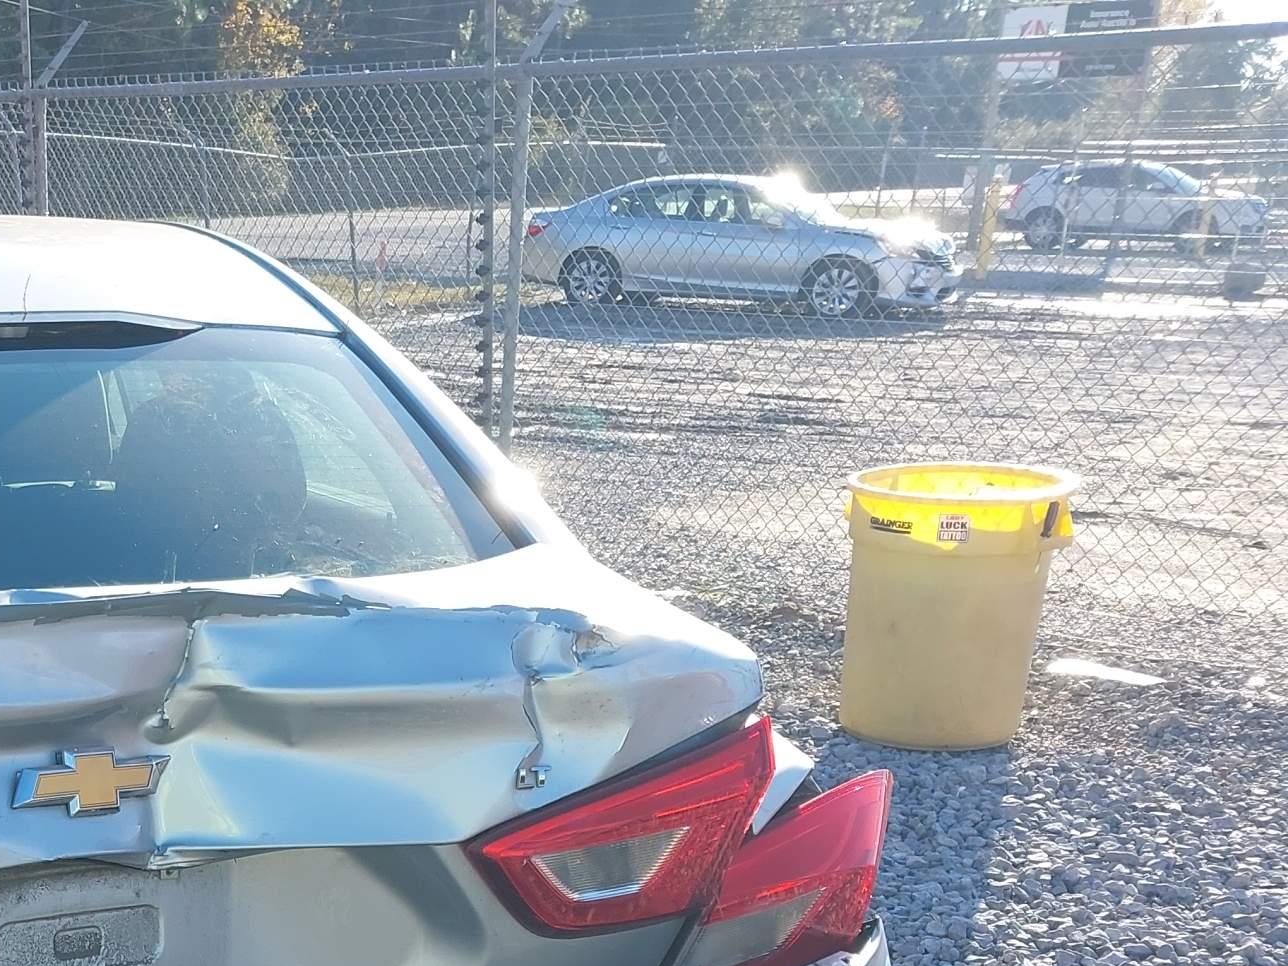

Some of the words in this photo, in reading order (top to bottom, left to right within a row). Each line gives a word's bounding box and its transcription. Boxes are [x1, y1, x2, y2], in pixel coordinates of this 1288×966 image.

[870, 516, 913, 530] GRAINGER
[940, 521, 968, 530] LUCK
[515, 765, 552, 790] LT
